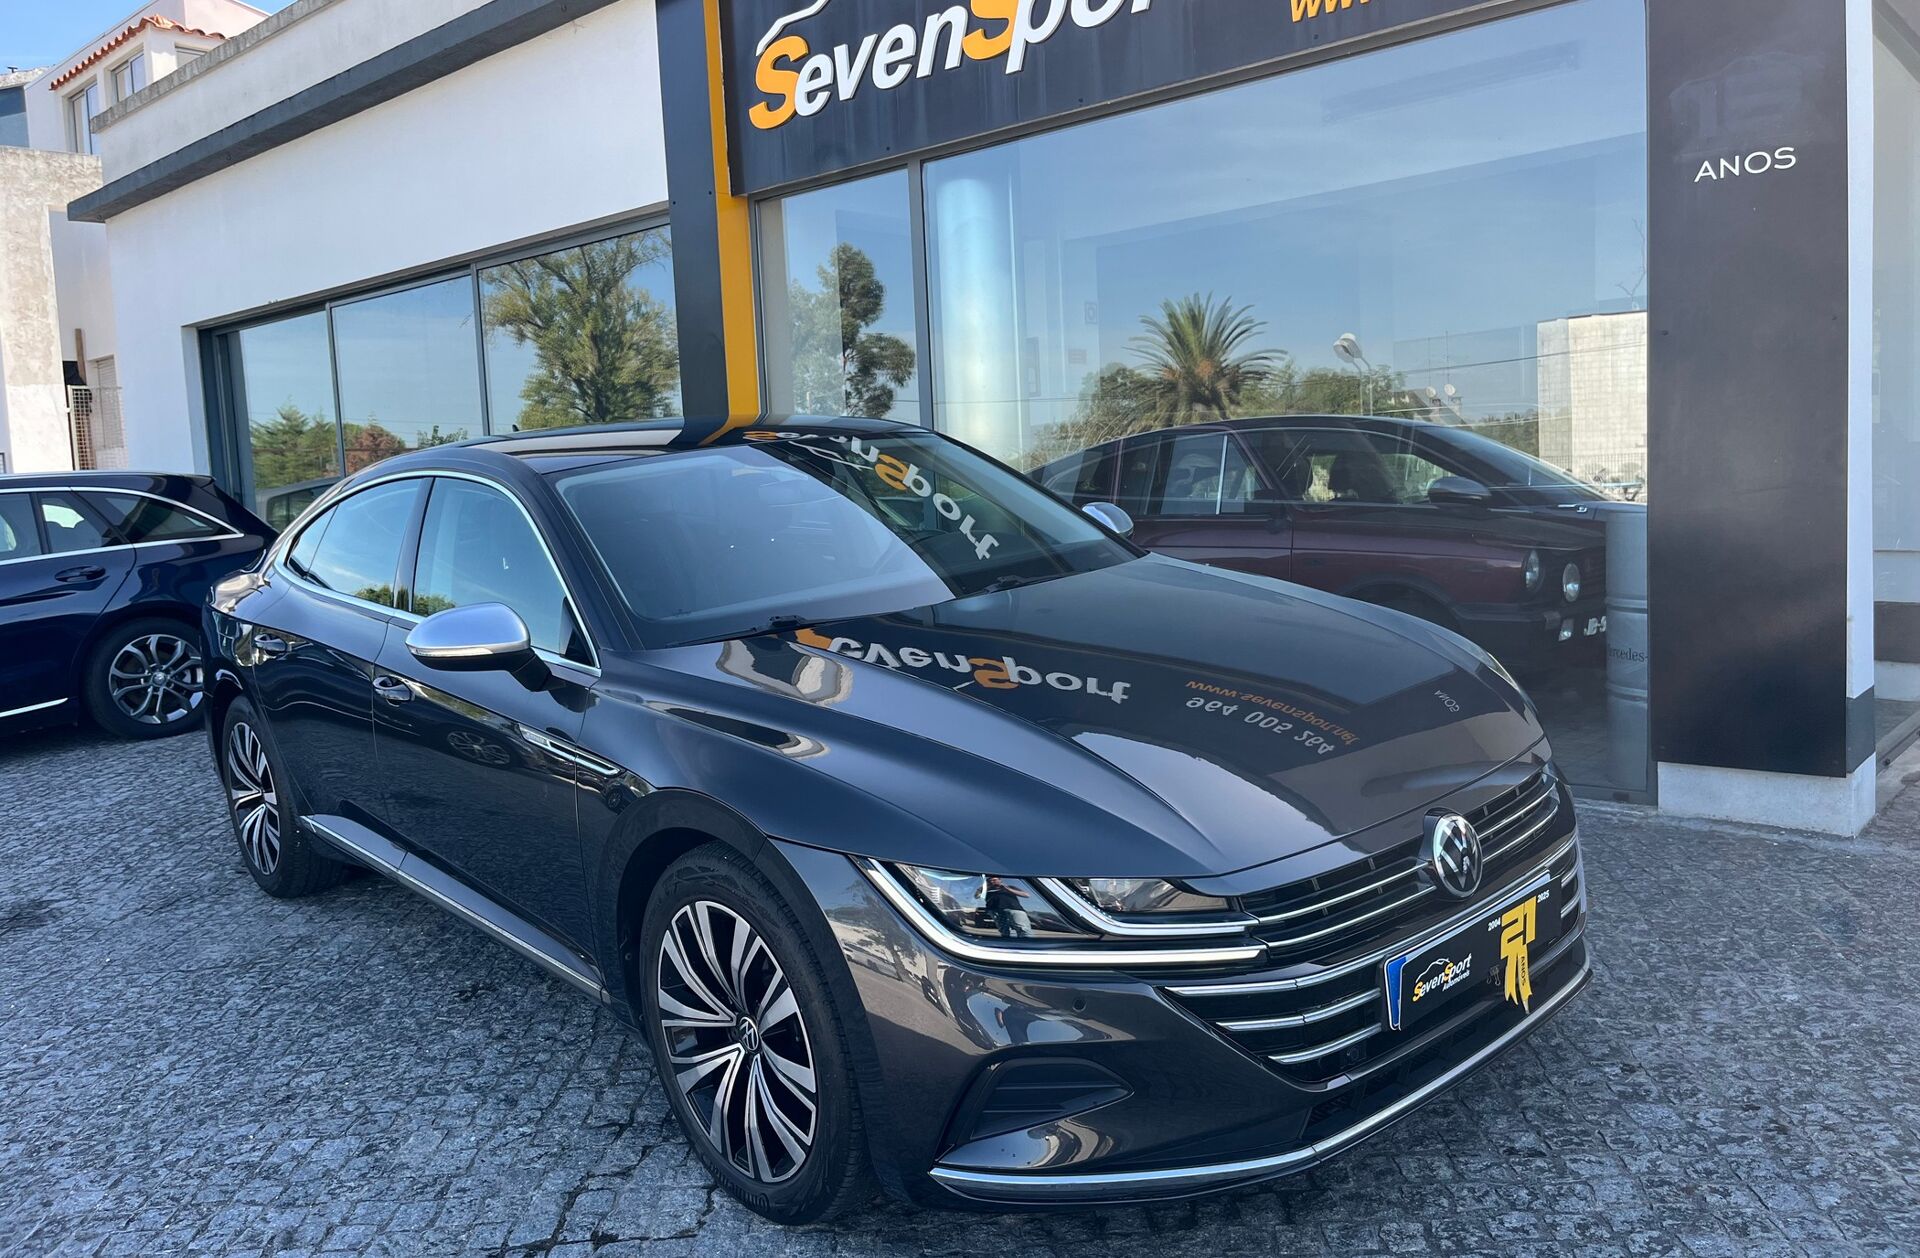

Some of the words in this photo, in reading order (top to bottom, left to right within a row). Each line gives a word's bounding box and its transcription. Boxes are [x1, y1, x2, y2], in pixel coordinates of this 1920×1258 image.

[749, 0, 1151, 130] SevenSpo
[1694, 147, 1796, 182] ANOS
[1412, 952, 1472, 1002] SevenSport
